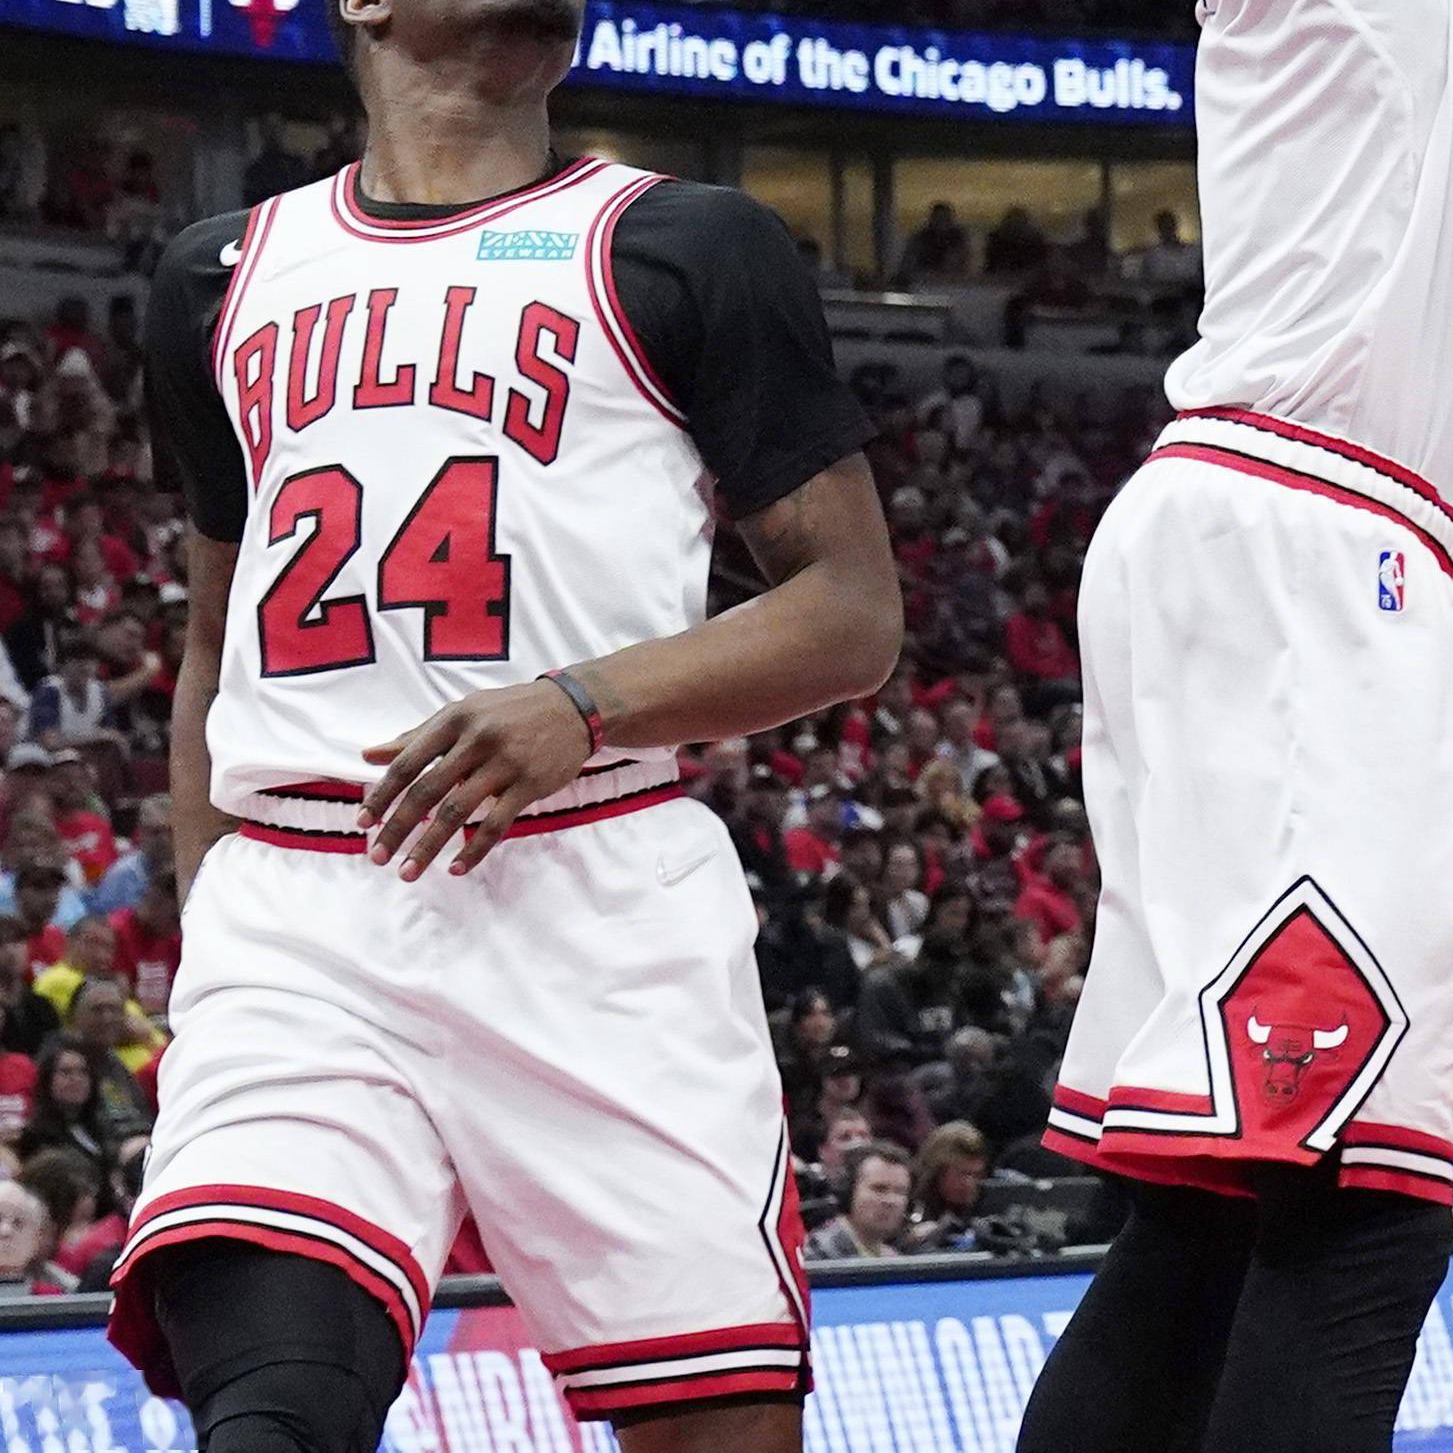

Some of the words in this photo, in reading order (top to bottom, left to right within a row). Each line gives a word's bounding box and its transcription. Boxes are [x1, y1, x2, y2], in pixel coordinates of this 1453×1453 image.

[587, 18, 738, 81] Airline
[742, 33, 792, 85] of
[798, 37, 869, 93] the
[874, 45, 1047, 112] Chicago
[1053, 56, 1183, 111] Bulls.
[233, 285, 581, 499] BULLS
[256, 454, 512, 679] 24
